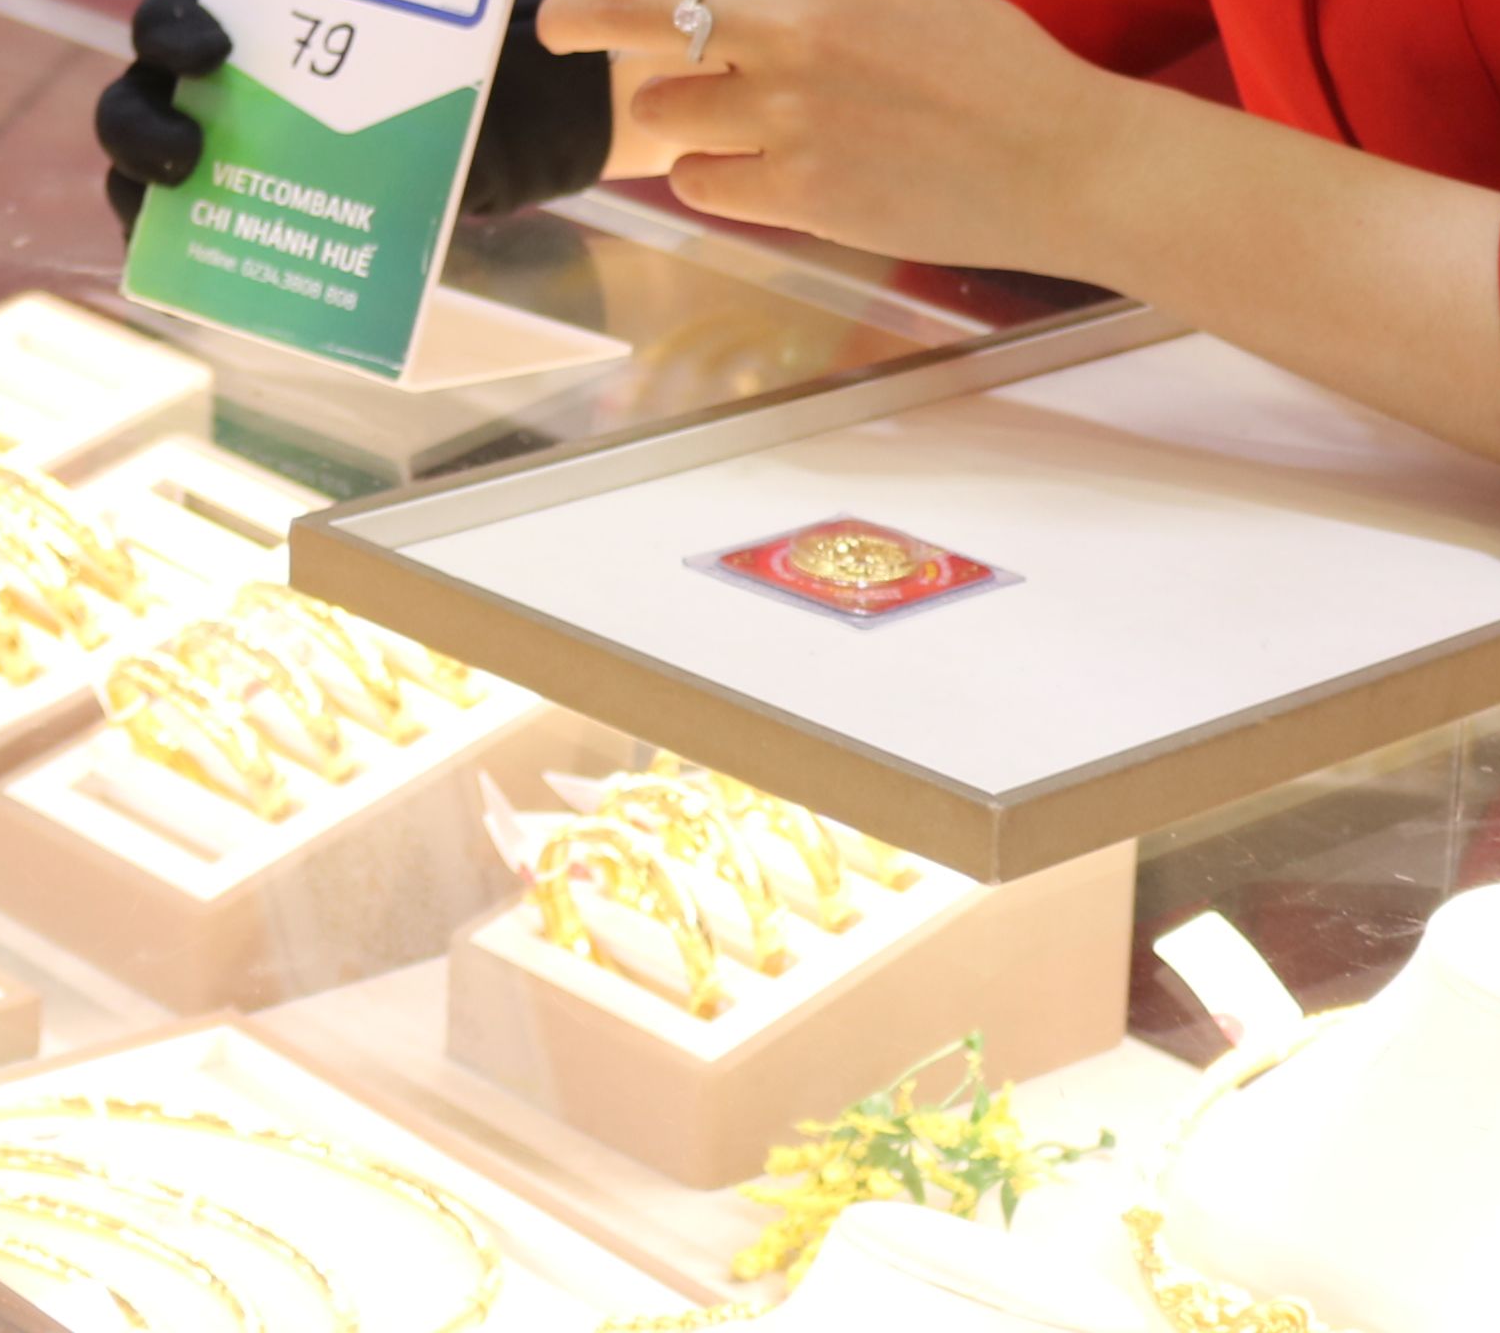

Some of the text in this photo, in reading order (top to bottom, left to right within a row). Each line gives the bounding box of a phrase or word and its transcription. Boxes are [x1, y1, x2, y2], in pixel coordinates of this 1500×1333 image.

[291, 9, 355, 77] 79
[213, 161, 376, 233] VIETCOMBANK
[190, 199, 379, 278] CHI NHÁNH HUẾ
